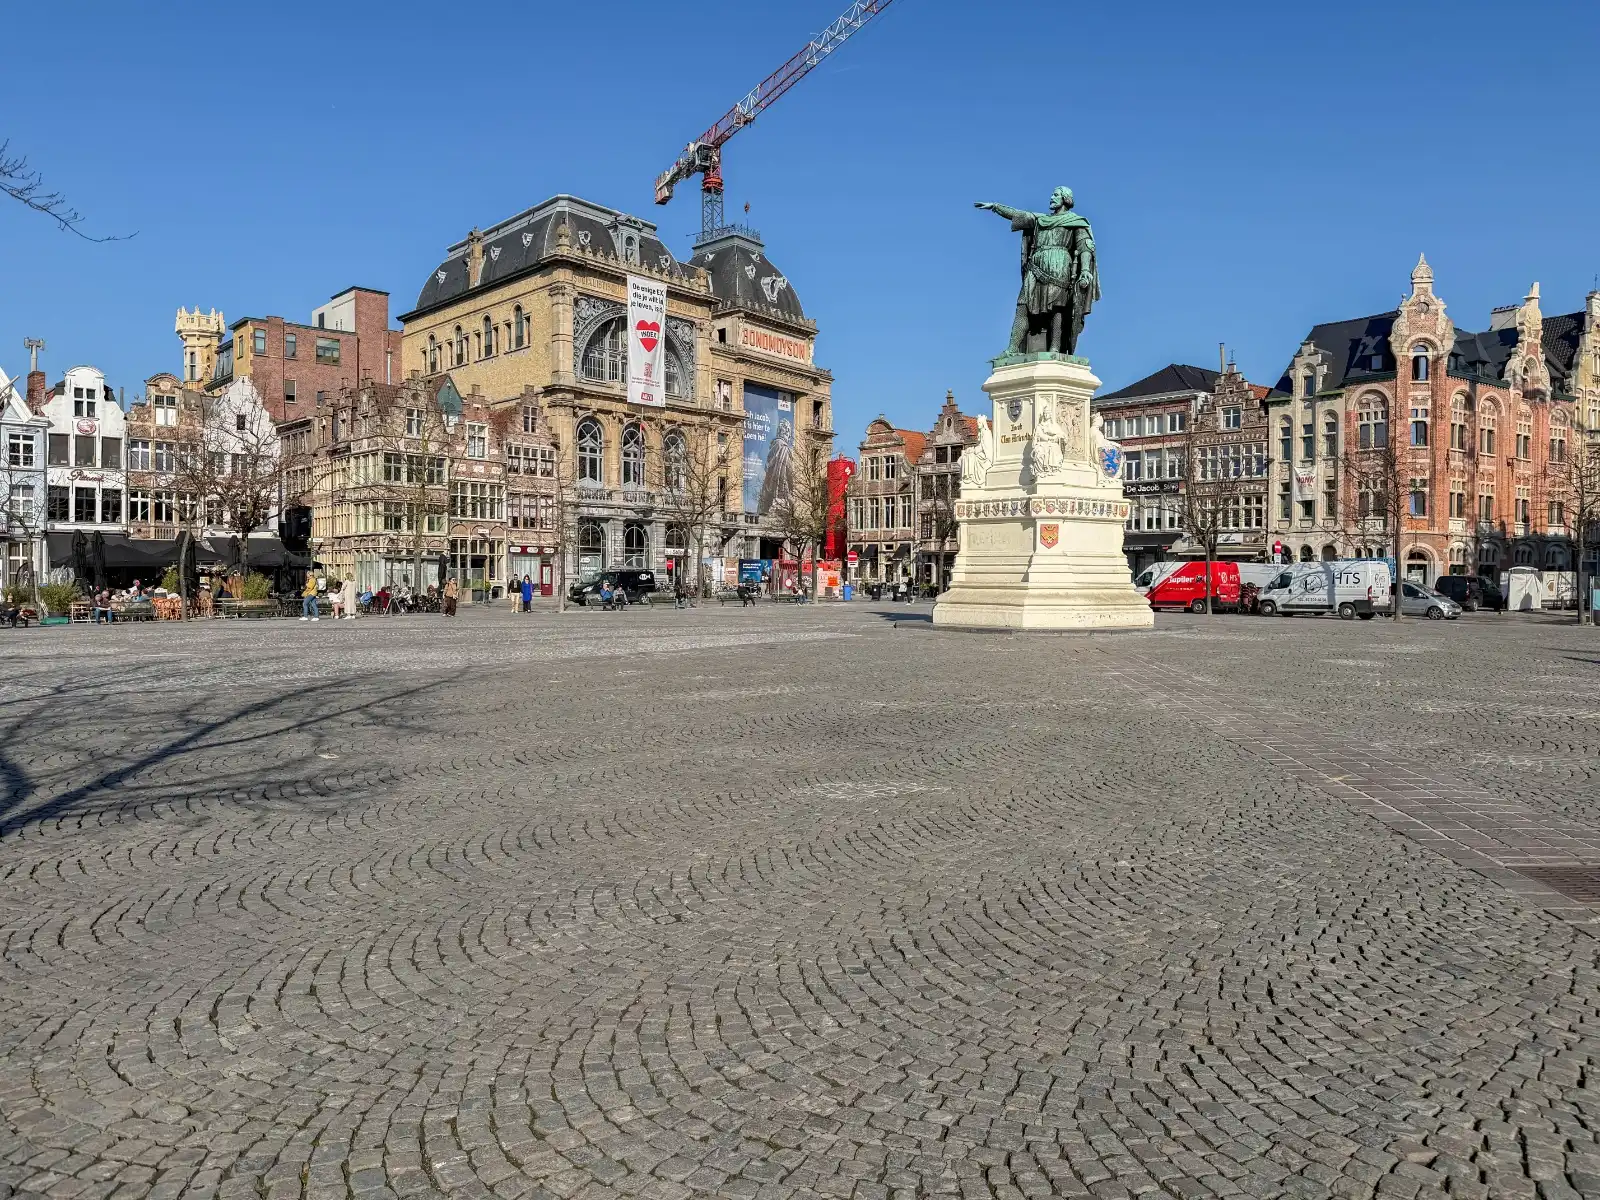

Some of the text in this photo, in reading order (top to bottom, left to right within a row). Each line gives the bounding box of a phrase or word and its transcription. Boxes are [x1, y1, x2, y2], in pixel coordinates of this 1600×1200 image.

[632, 283, 640, 291] De
[640, 286, 656, 295] enige
[632, 291, 642, 300] die
[642, 293, 648, 301] je
[1126, 484, 1160, 493] De Jacob
[1331, 572, 1360, 585] HTS
